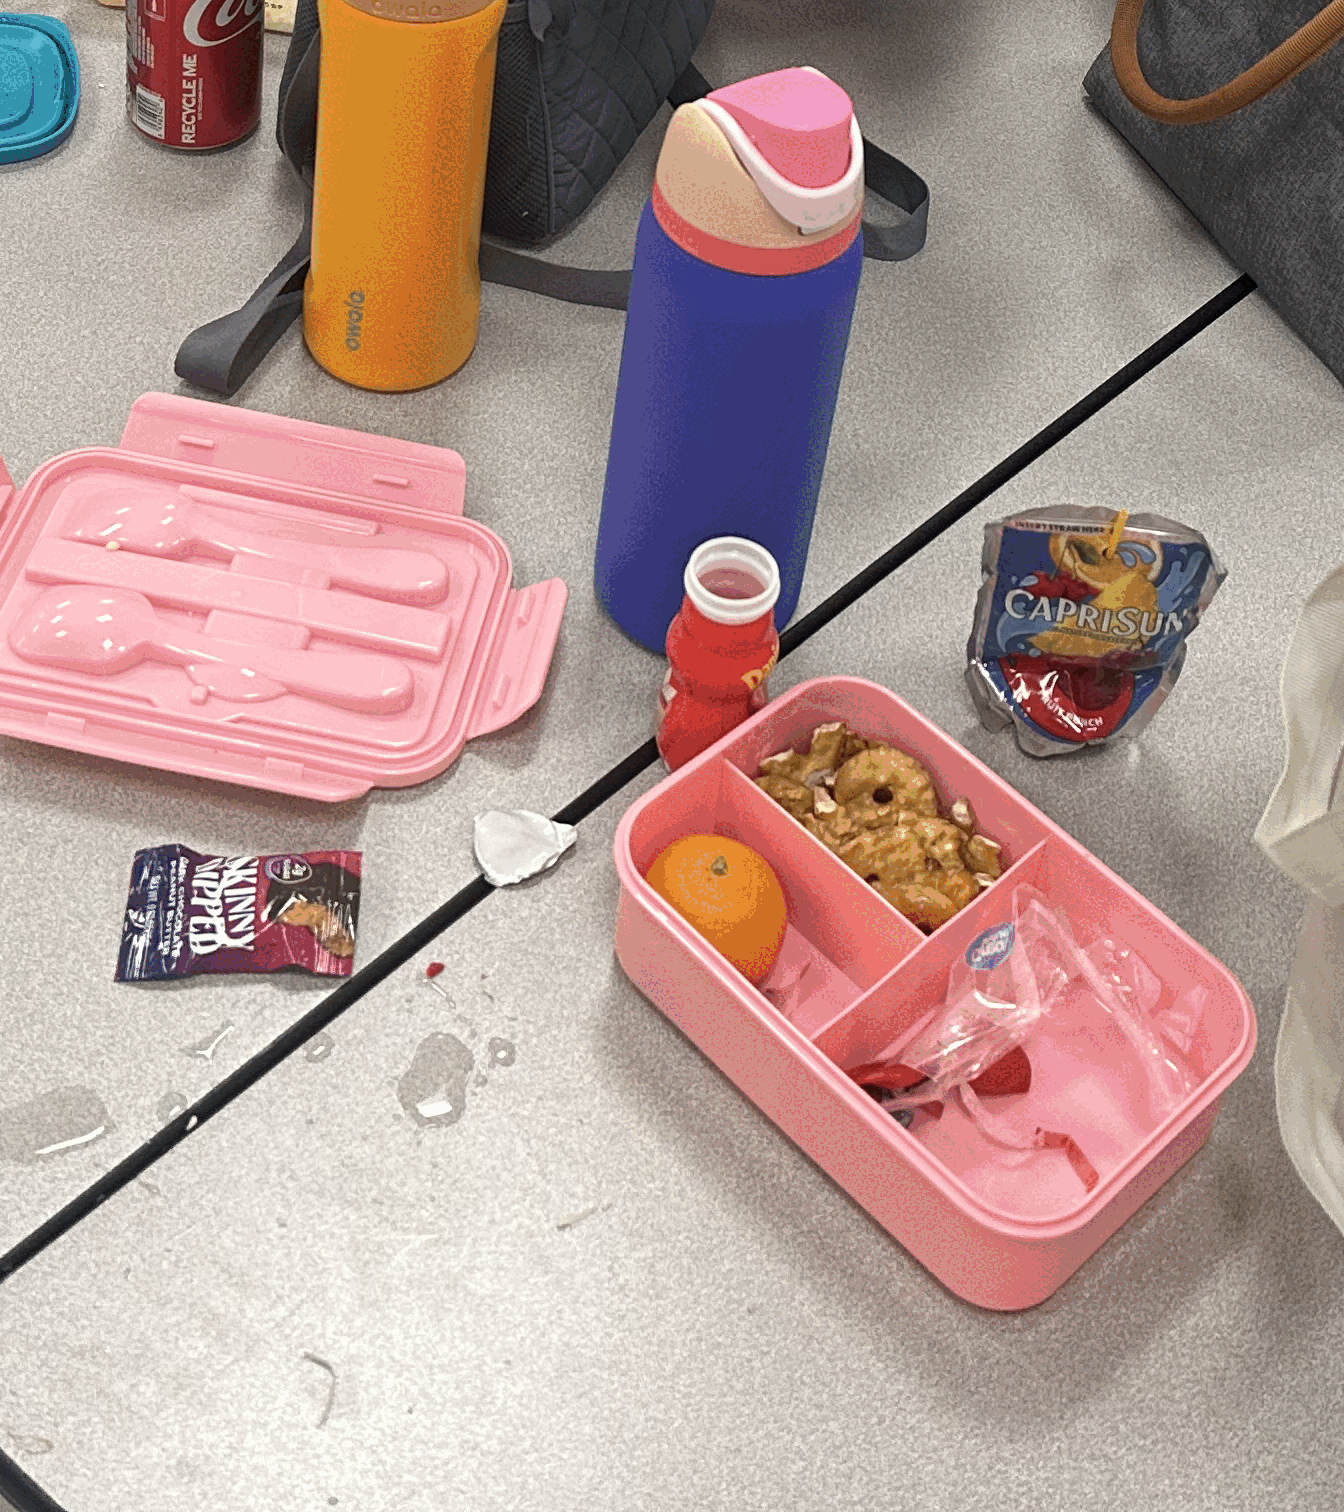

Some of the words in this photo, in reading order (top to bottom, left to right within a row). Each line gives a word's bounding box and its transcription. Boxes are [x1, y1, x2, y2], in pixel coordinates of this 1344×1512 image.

[371, 0, 444, 18] owala
[182, 53, 197, 78] ME
[181, 79, 197, 144] RECYCLE
[345, 289, 365, 352] owala
[1005, 589, 1184, 637] CAPRISUN
[168, 859, 177, 907] PEANUT
[178, 857, 190, 883] DARK
[172, 886, 186, 958] CHOCOLATE
[189, 857, 226, 955] NIPPED
[221, 856, 260, 952] SKINNY
[162, 910, 175, 957] BUTTER
